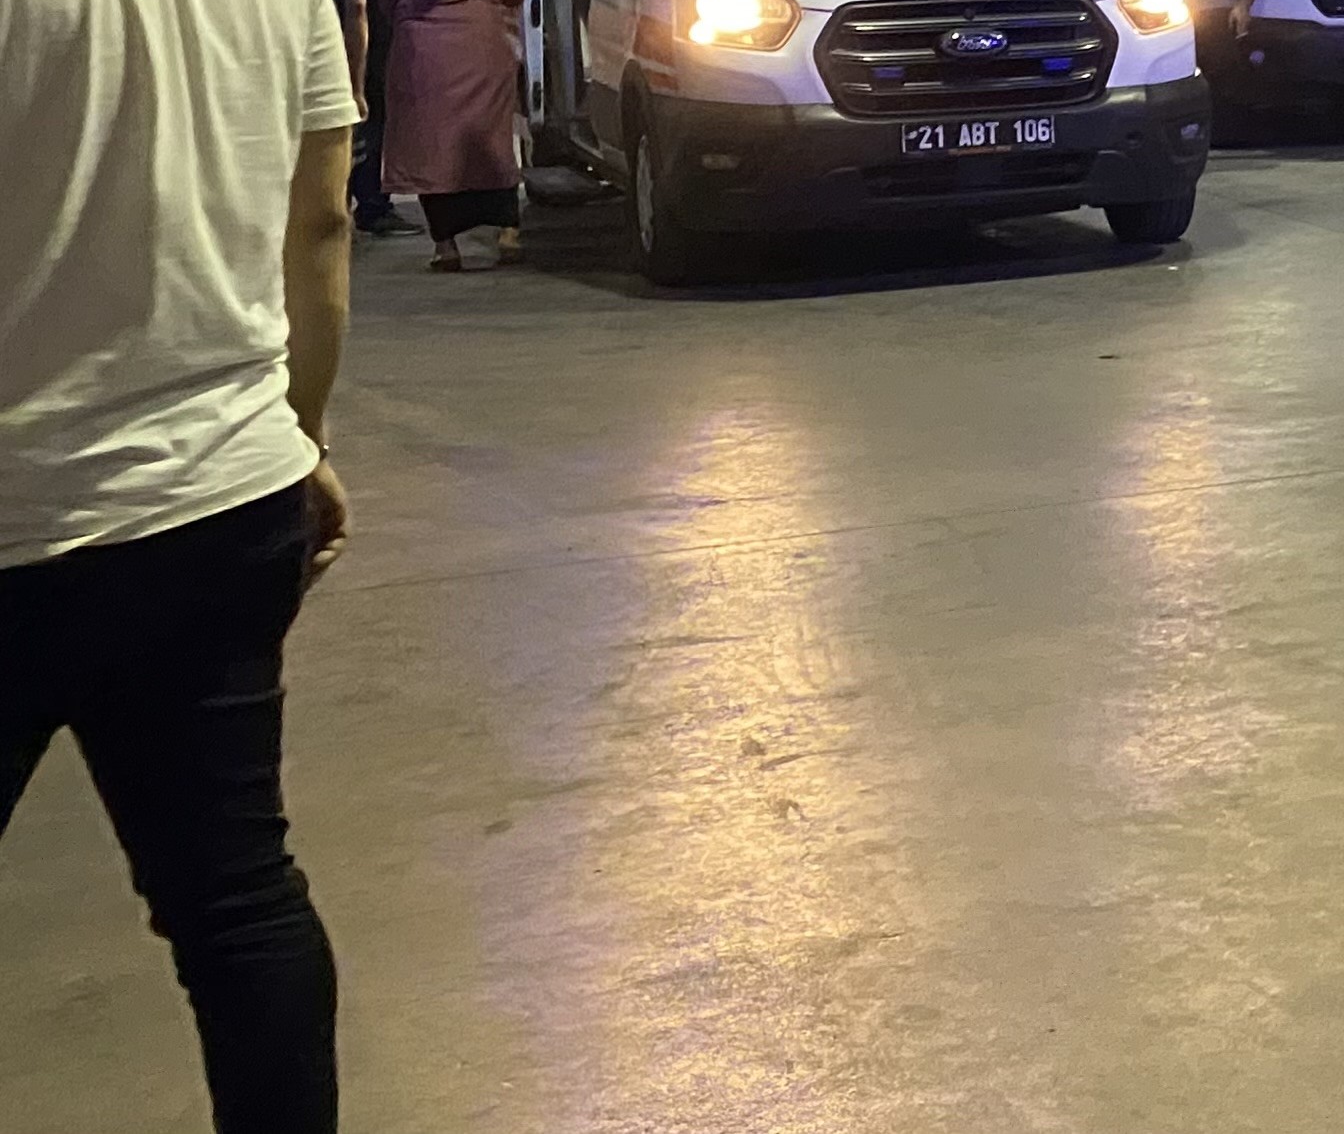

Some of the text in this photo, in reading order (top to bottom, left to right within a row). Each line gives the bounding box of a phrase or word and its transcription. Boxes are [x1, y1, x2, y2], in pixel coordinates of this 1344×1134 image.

[918, 117, 1052, 150] 21 ABT 106
